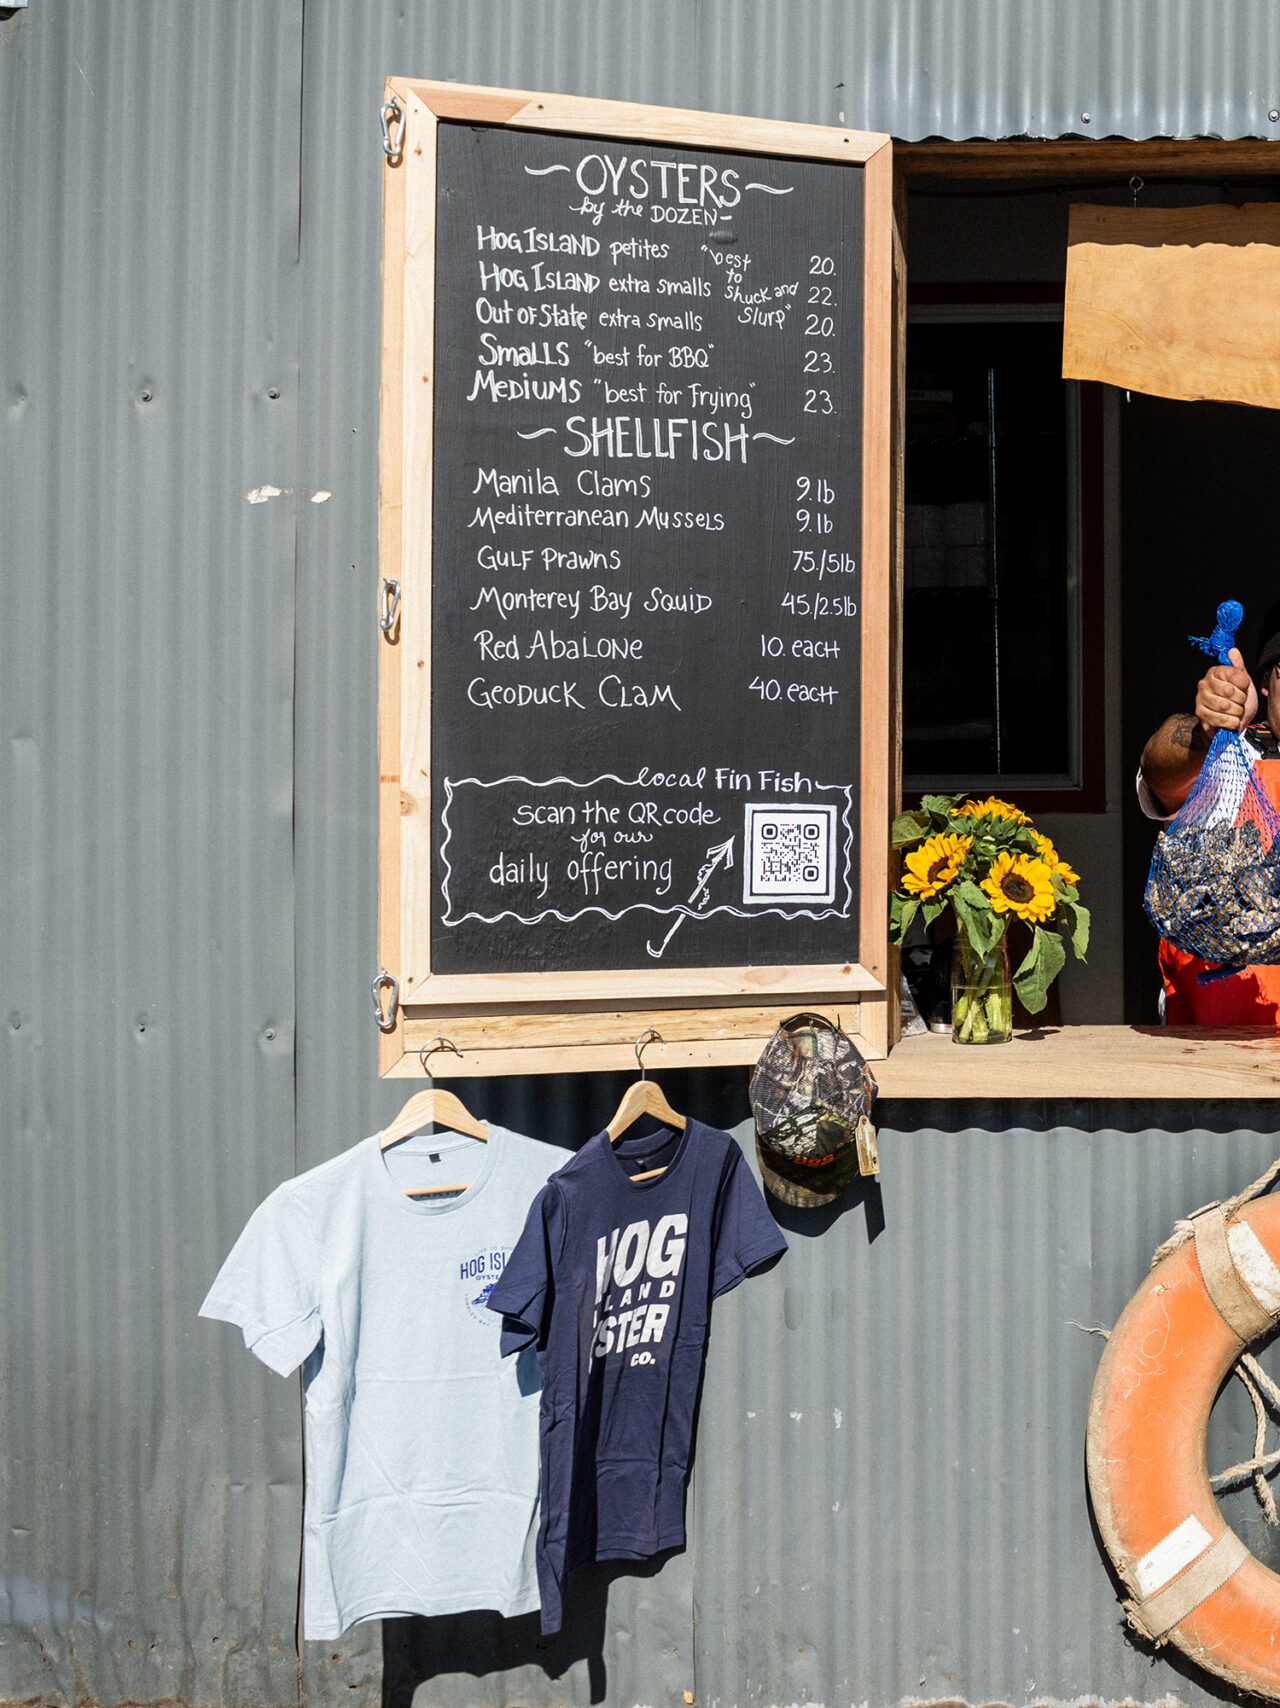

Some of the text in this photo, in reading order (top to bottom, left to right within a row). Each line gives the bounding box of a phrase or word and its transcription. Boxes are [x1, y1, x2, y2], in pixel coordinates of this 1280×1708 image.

[576, 154, 741, 208] OYSTERS
[569, 196, 605, 225] by
[611, 199, 643, 216] the
[609, 238, 670, 265] petites
[609, 273, 650, 293] extra
[657, 277, 711, 297] smalls
[726, 268, 742, 283] to
[774, 282, 799, 297] and
[476, 297, 513, 324] Out
[539, 304, 587, 330] State
[599, 308, 641, 328] extra
[646, 311, 702, 331] smalls
[637, 344, 662, 367] for
[668, 344, 714, 368] BBQ"
[656, 382, 682, 404] for
[688, 382, 755, 419] Frying"
[564, 416, 749, 463] SHELLFISH
[473, 468, 559, 497] Manila
[577, 470, 651, 498] Clams
[467, 504, 628, 534] Mediterranean
[541, 548, 621, 571] Prawns
[469, 587, 580, 620] Monterey
[590, 585, 632, 619] Bay
[474, 630, 519, 661] Red
[637, 767, 811, 793] local Fin Fish
[513, 800, 721, 826] scan the QR code
[571, 828, 653, 853] for our
[489, 851, 671, 899] daily offering
[460, 1252, 506, 1280] HOG ISL
[595, 1213, 688, 1306] HOG
[630, 1351, 657, 1367] CO.
